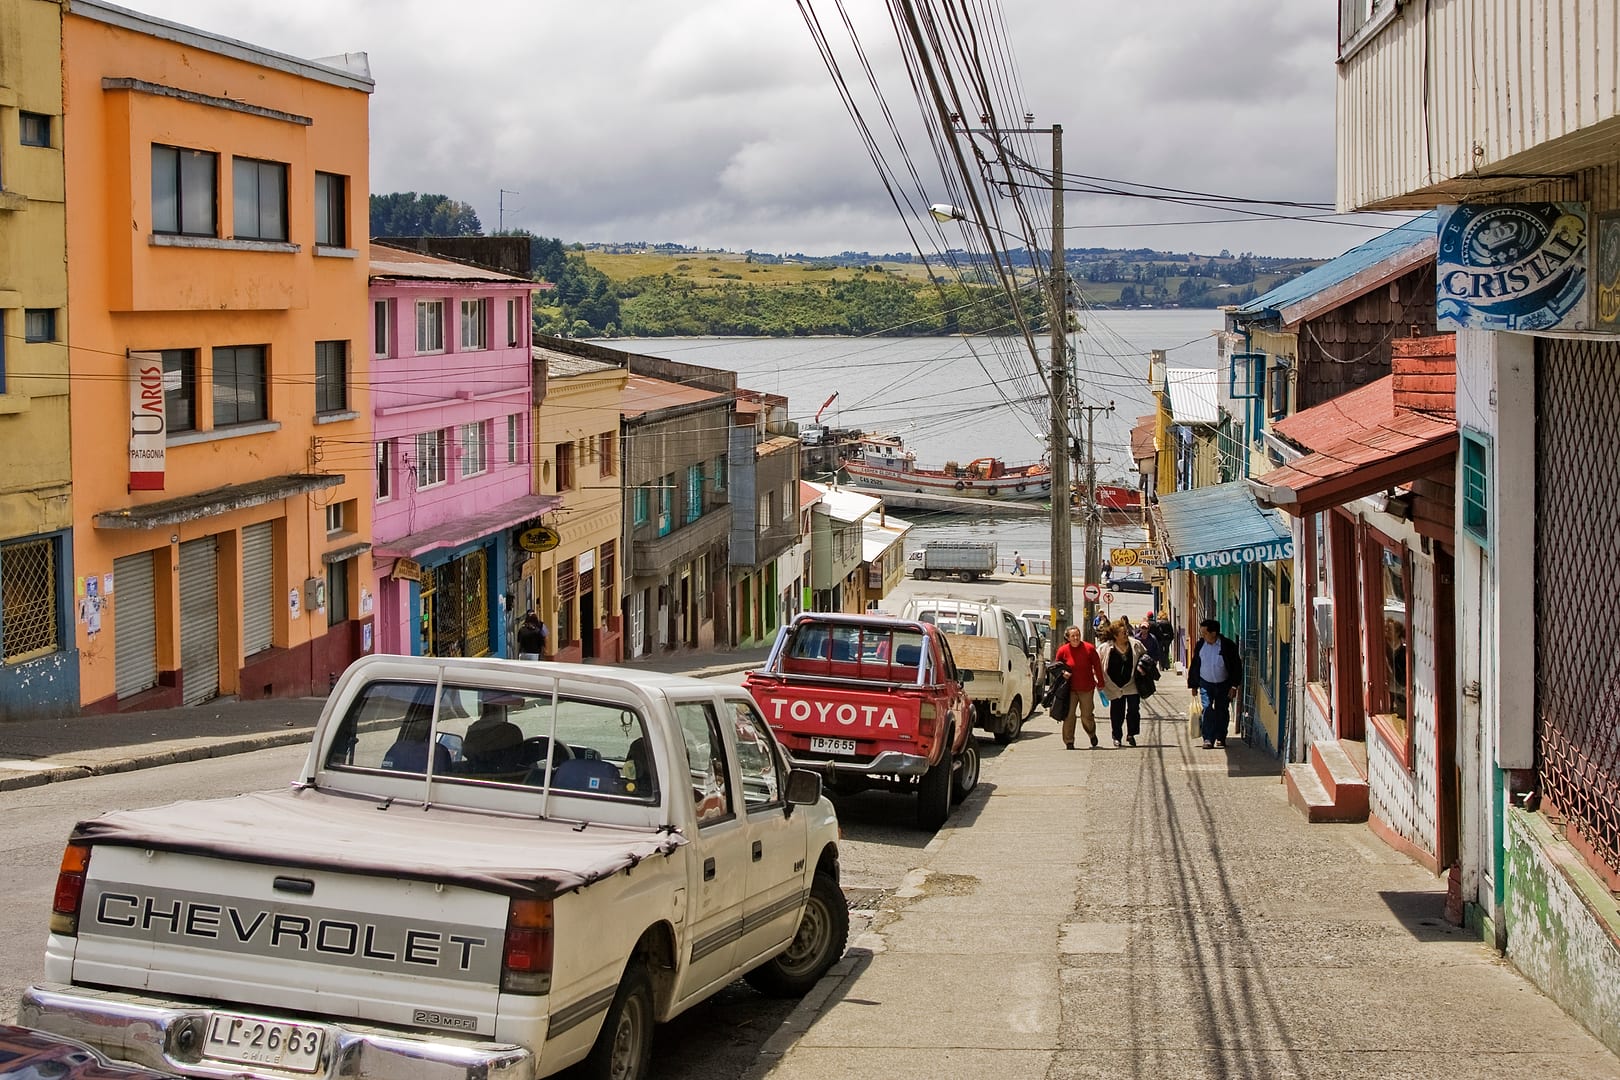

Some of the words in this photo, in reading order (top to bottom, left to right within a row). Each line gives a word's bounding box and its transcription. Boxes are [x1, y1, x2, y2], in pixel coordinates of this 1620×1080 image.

[1443, 233, 1583, 298] CRISTAL
[131, 449, 164, 459] PATAGONIA
[1184, 542, 1294, 570] FOTOCOPIAS
[770, 699, 899, 729] TOYOTA
[96, 891, 487, 970] CHEVROLET
[415, 1011, 441, 1024] 2.3
[443, 1017, 476, 1029] MPFI
[242, 1051, 281, 1064] CHILE
